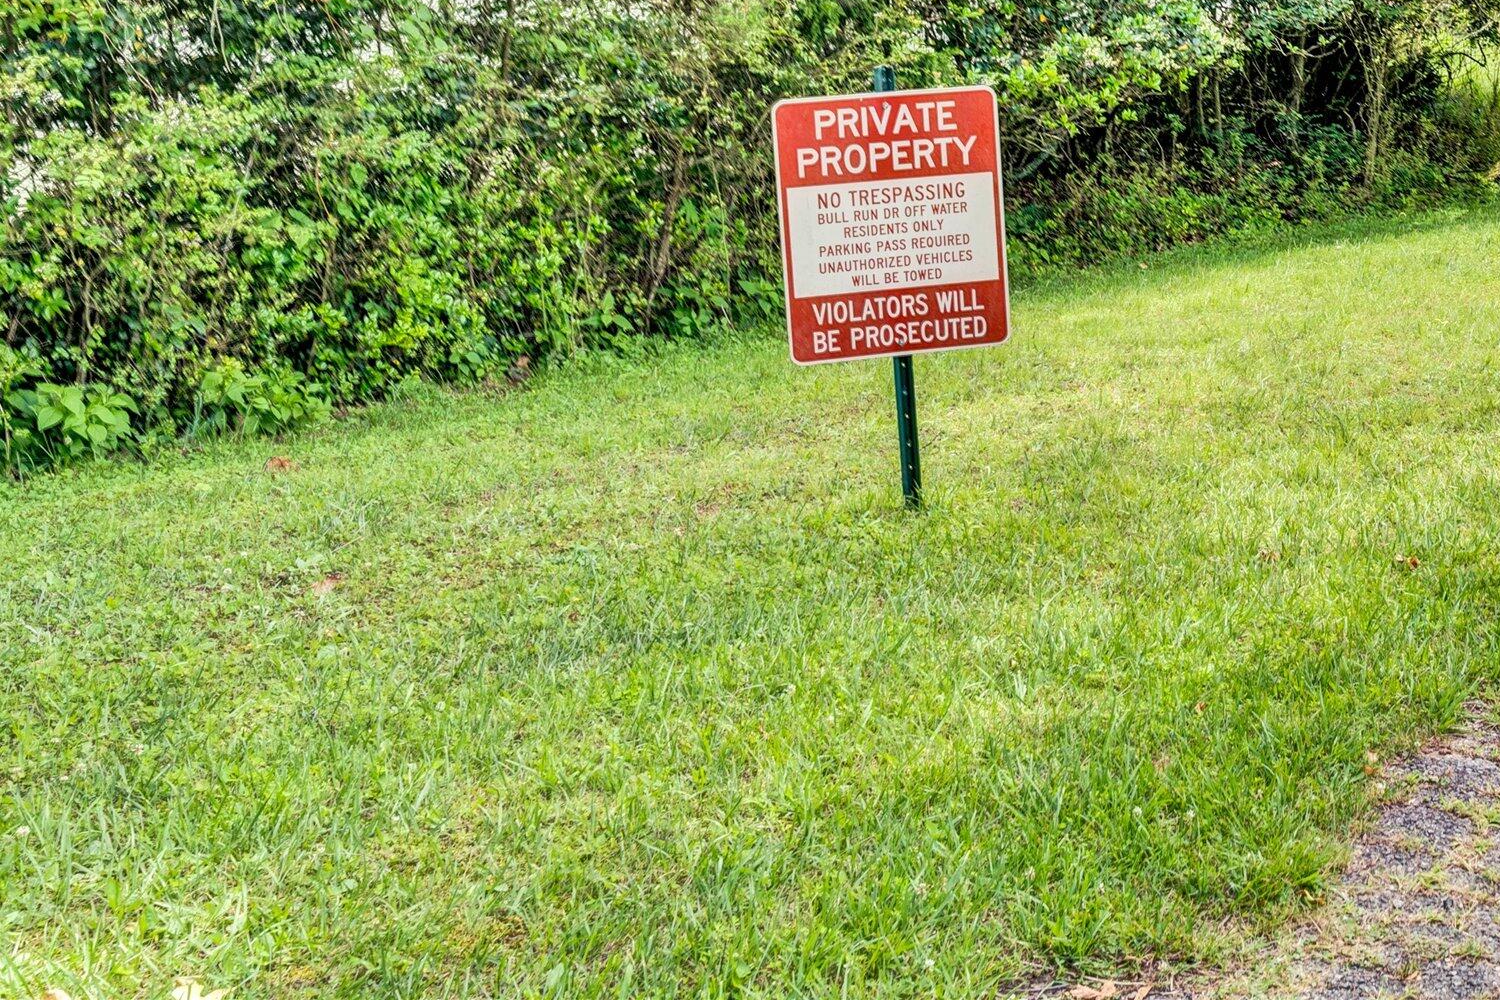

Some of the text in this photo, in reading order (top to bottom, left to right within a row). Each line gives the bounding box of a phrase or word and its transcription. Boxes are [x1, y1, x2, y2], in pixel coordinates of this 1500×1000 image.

[813, 101, 958, 140] PRIVATE
[796, 135, 977, 178] PROPERTY
[818, 182, 965, 209] NO TRESPASSING
[817, 202, 968, 225] BULL RUN DR OFF WATER
[844, 219, 944, 238] RESIDENTS ONLY
[819, 233, 970, 257] PARKING PASS REQUIRED
[819, 250, 973, 274] UNAUTHORIZED VEHICLES
[852, 268, 942, 287] WILL BE TOWED
[812, 289, 985, 326] VIOLATORS WILL
[813, 316, 987, 354] BE PROSECUTED
